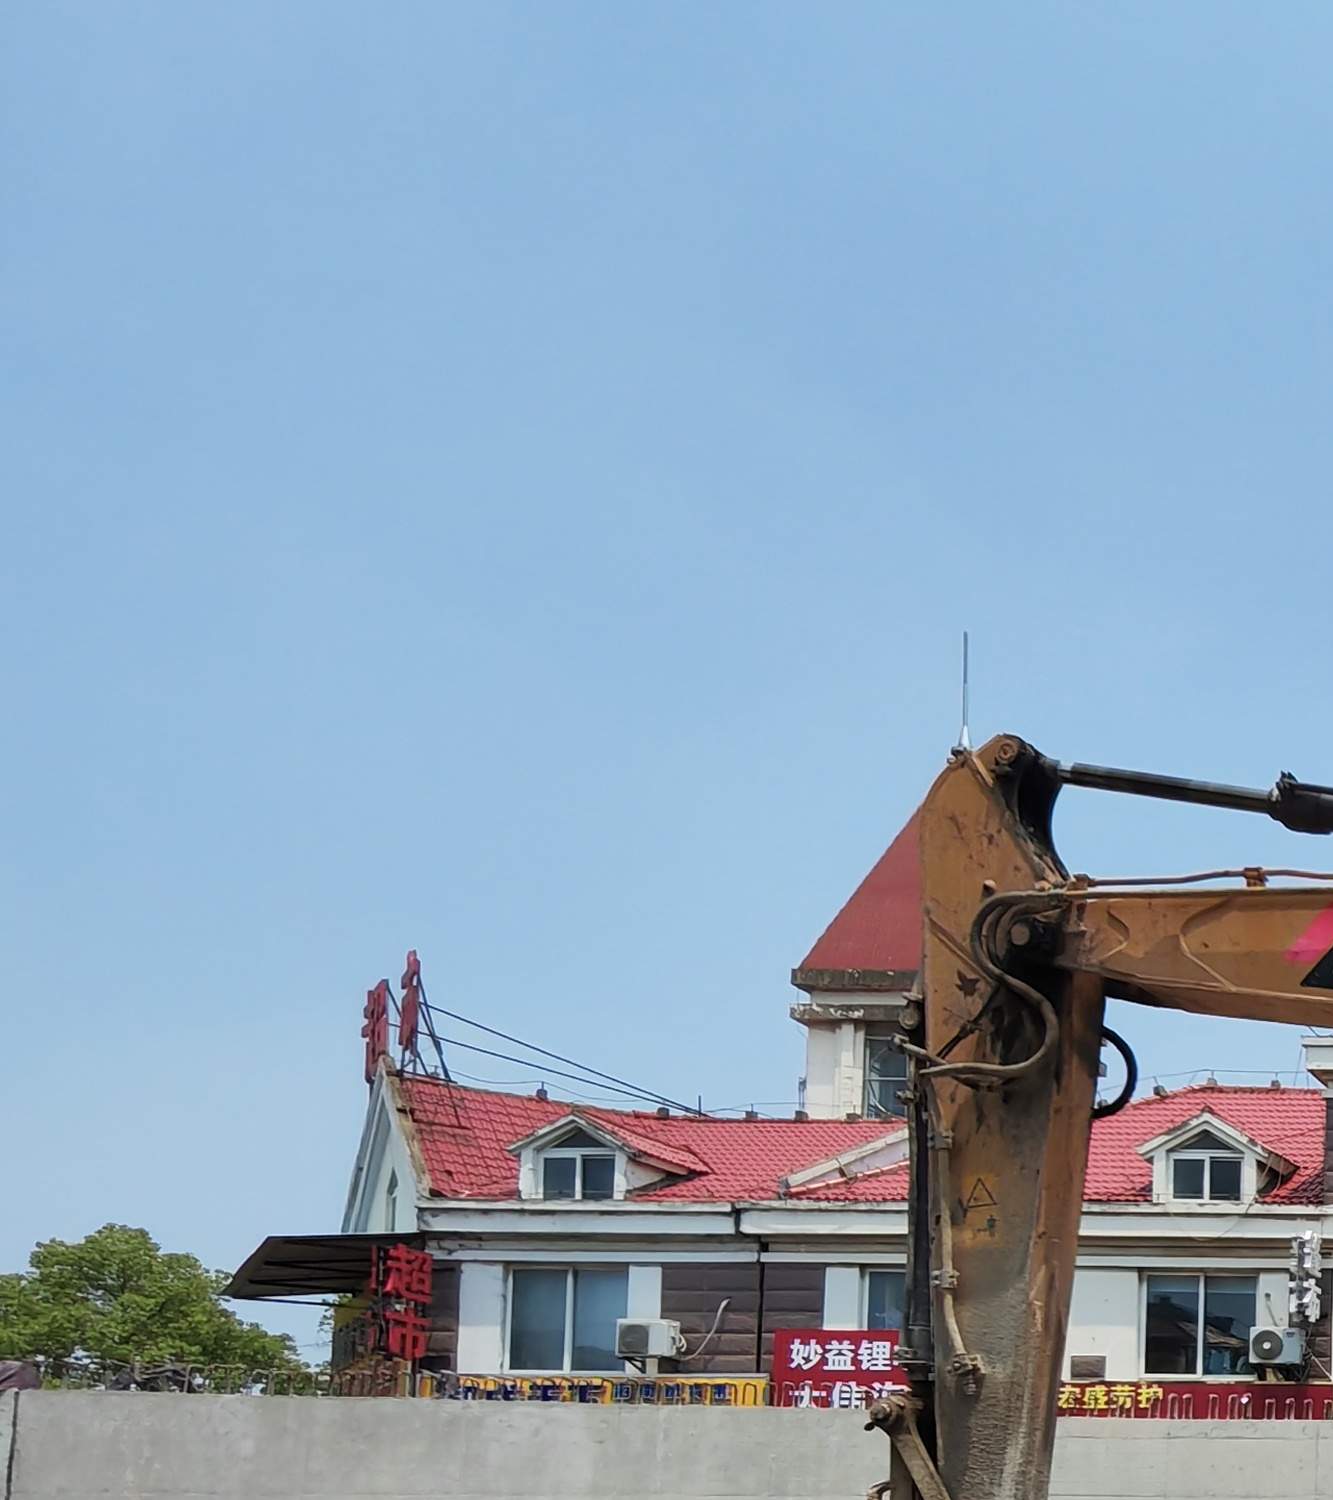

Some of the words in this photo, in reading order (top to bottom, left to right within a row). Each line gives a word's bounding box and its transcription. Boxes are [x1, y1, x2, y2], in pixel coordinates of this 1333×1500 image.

[384, 1243, 432, 1361] 超市
[789, 1338, 900, 1371] 妙益锂
